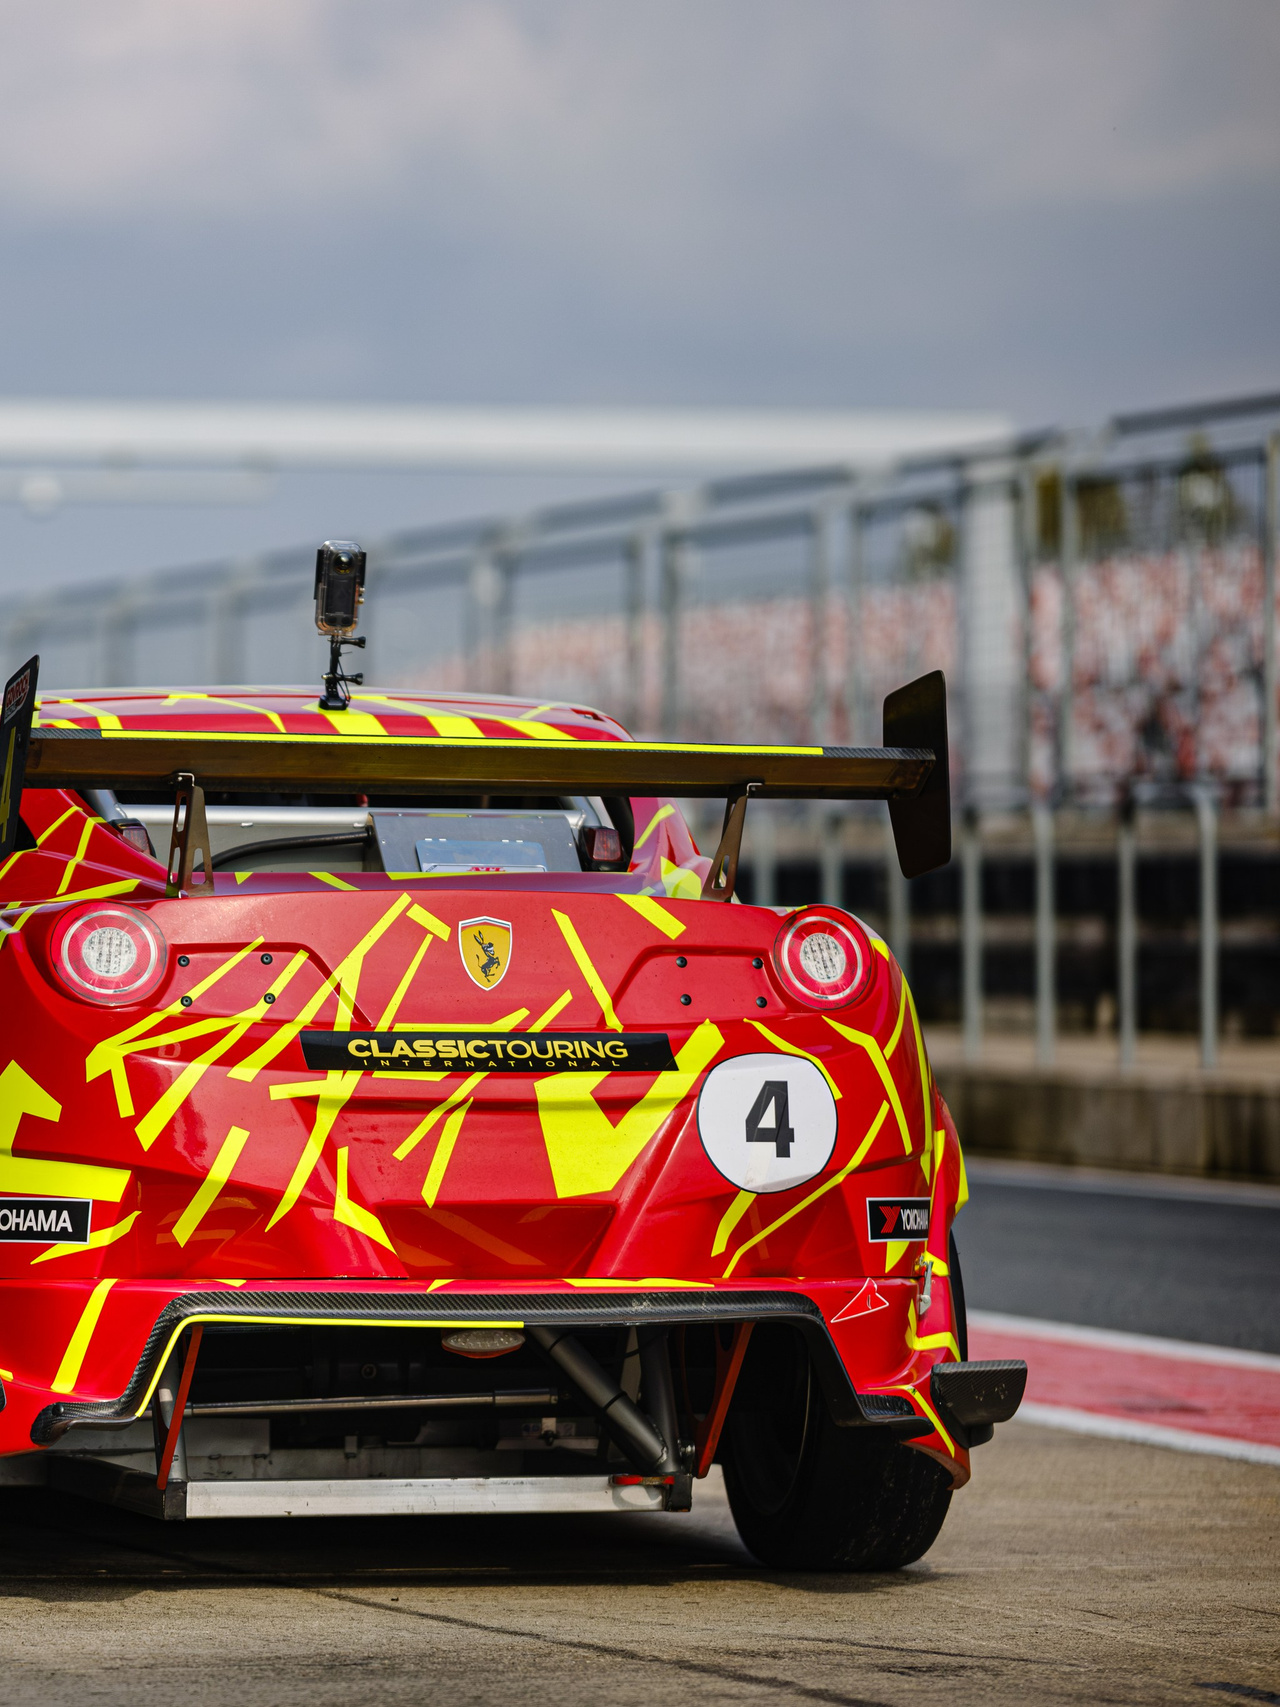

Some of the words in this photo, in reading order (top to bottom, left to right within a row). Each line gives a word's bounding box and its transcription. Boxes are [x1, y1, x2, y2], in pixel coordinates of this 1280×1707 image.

[347, 1039, 629, 1059] CLASSICTOURING
[363, 1059, 620, 1068] INTERNATIONAL
[745, 1080, 795, 1158] 4
